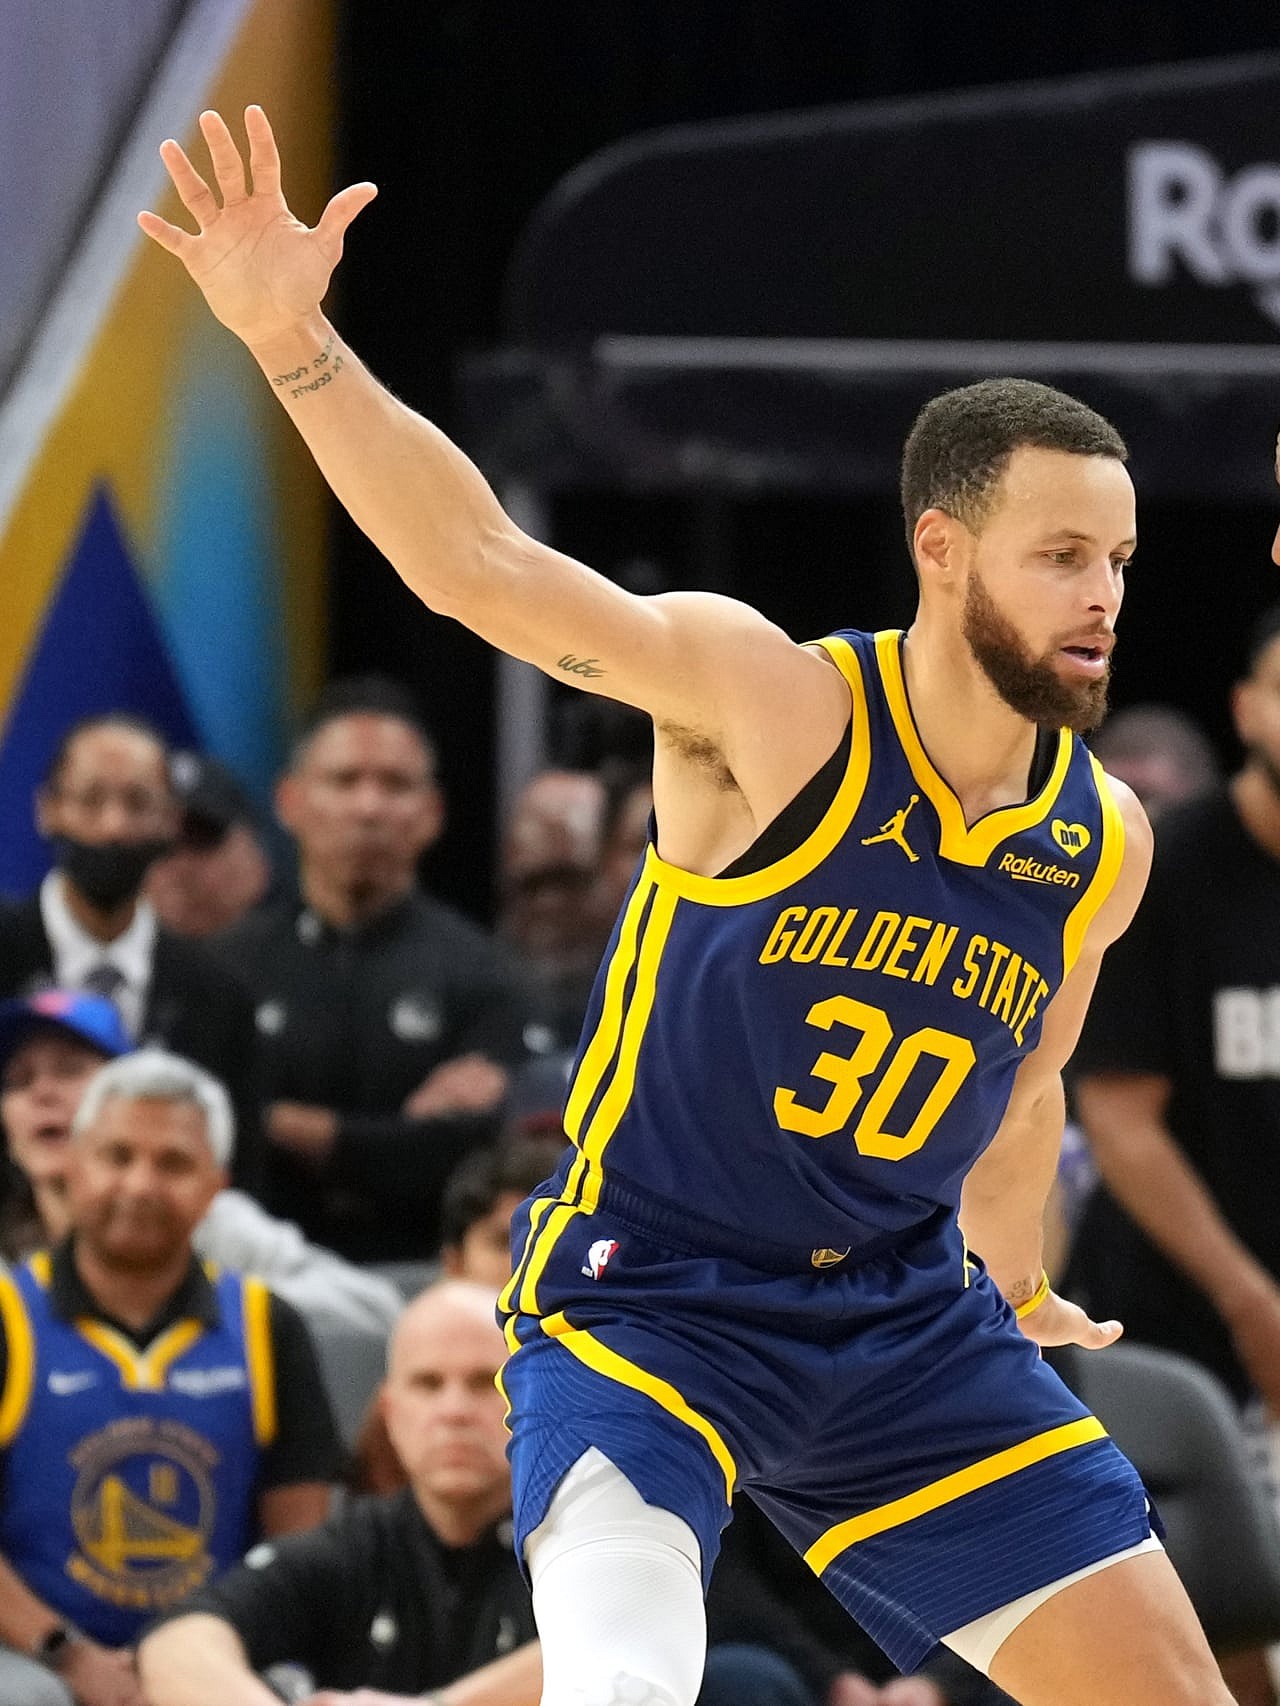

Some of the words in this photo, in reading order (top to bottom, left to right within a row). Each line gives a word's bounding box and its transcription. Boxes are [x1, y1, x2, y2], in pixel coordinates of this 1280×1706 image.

[998, 852, 1081, 889] Rakuten
[758, 904, 960, 987] GOLDEN
[951, 933, 1050, 1048] STATE
[773, 995, 977, 1162] 30
